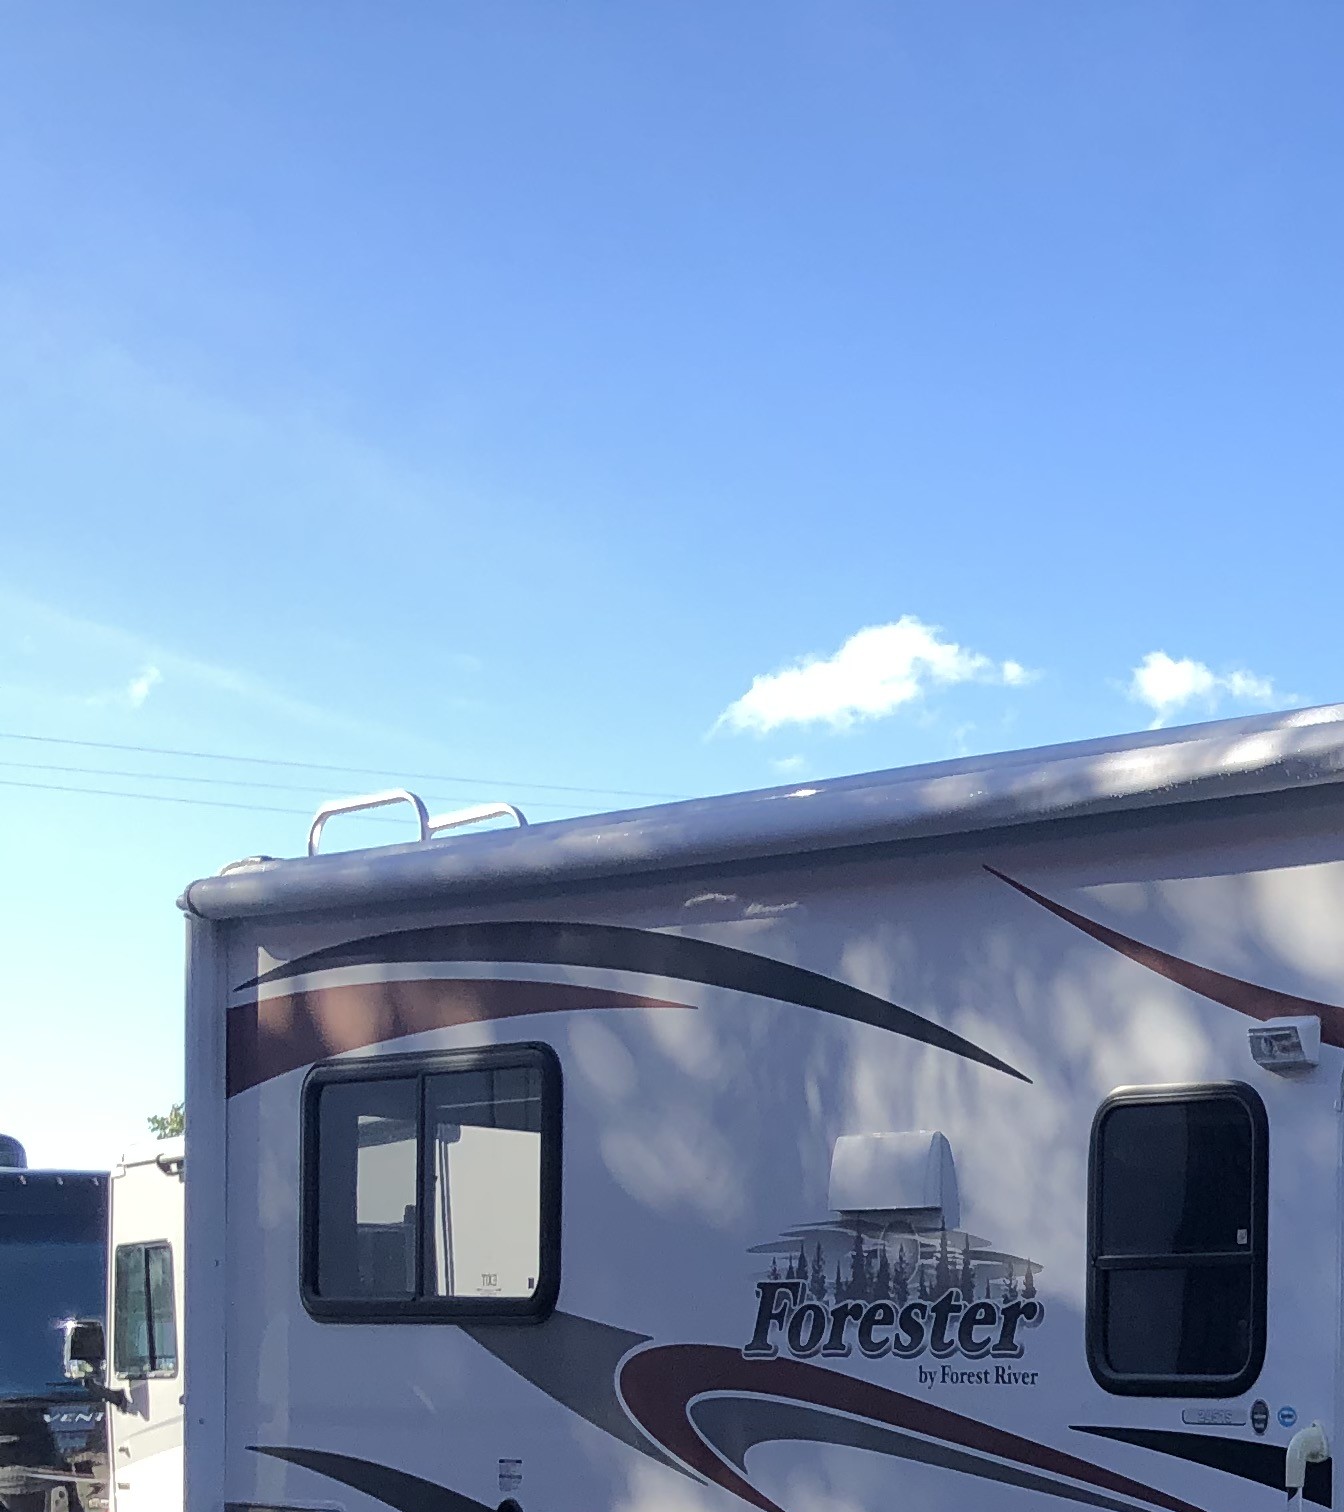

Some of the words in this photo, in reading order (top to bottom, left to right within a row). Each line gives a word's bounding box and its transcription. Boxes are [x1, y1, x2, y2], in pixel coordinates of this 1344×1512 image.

[742, 1279, 1045, 1361] Forester
[918, 1364, 938, 1390] by
[940, 1364, 991, 1385] Forest
[994, 1364, 1039, 1386] River
